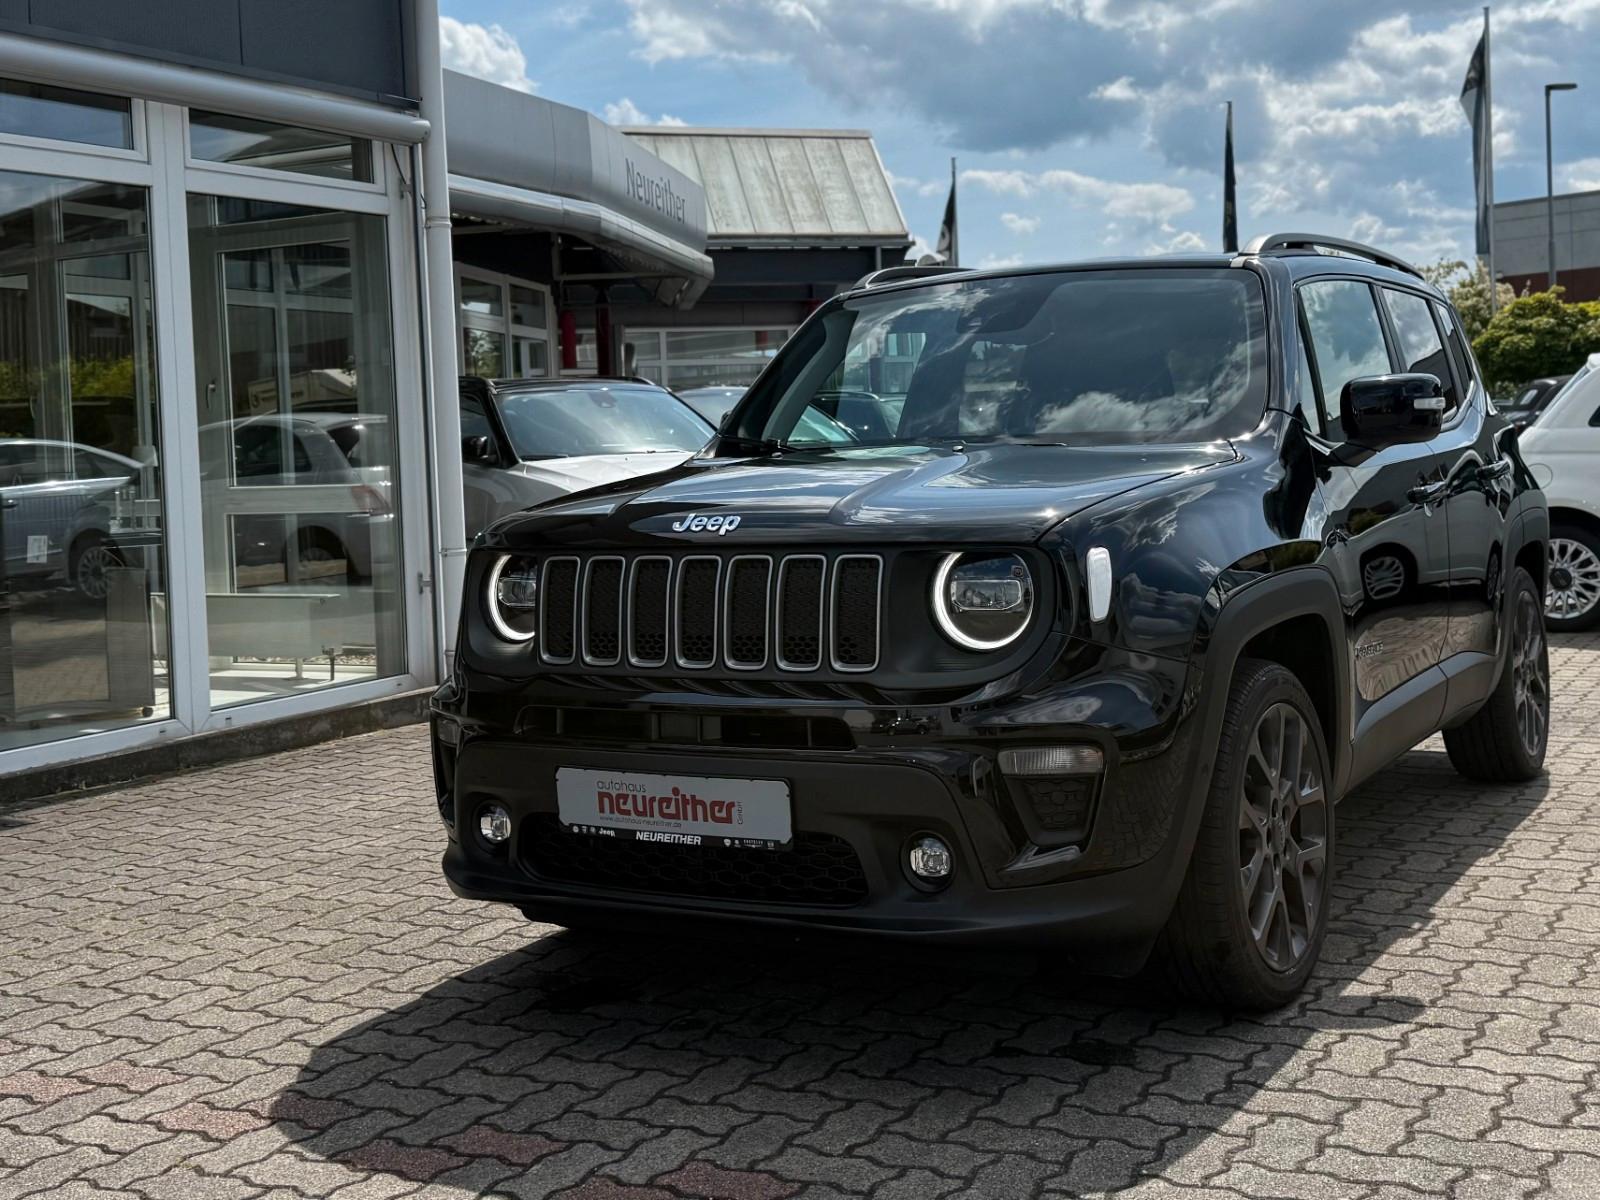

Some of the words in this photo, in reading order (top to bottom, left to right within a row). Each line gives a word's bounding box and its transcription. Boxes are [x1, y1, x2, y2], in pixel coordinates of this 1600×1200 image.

[625, 157, 685, 224] Neureither
[672, 513, 741, 536] Jeep
[597, 779, 647, 793] autohaus
[597, 786, 736, 825] neureither
[636, 831, 702, 846] NEUREITHER
